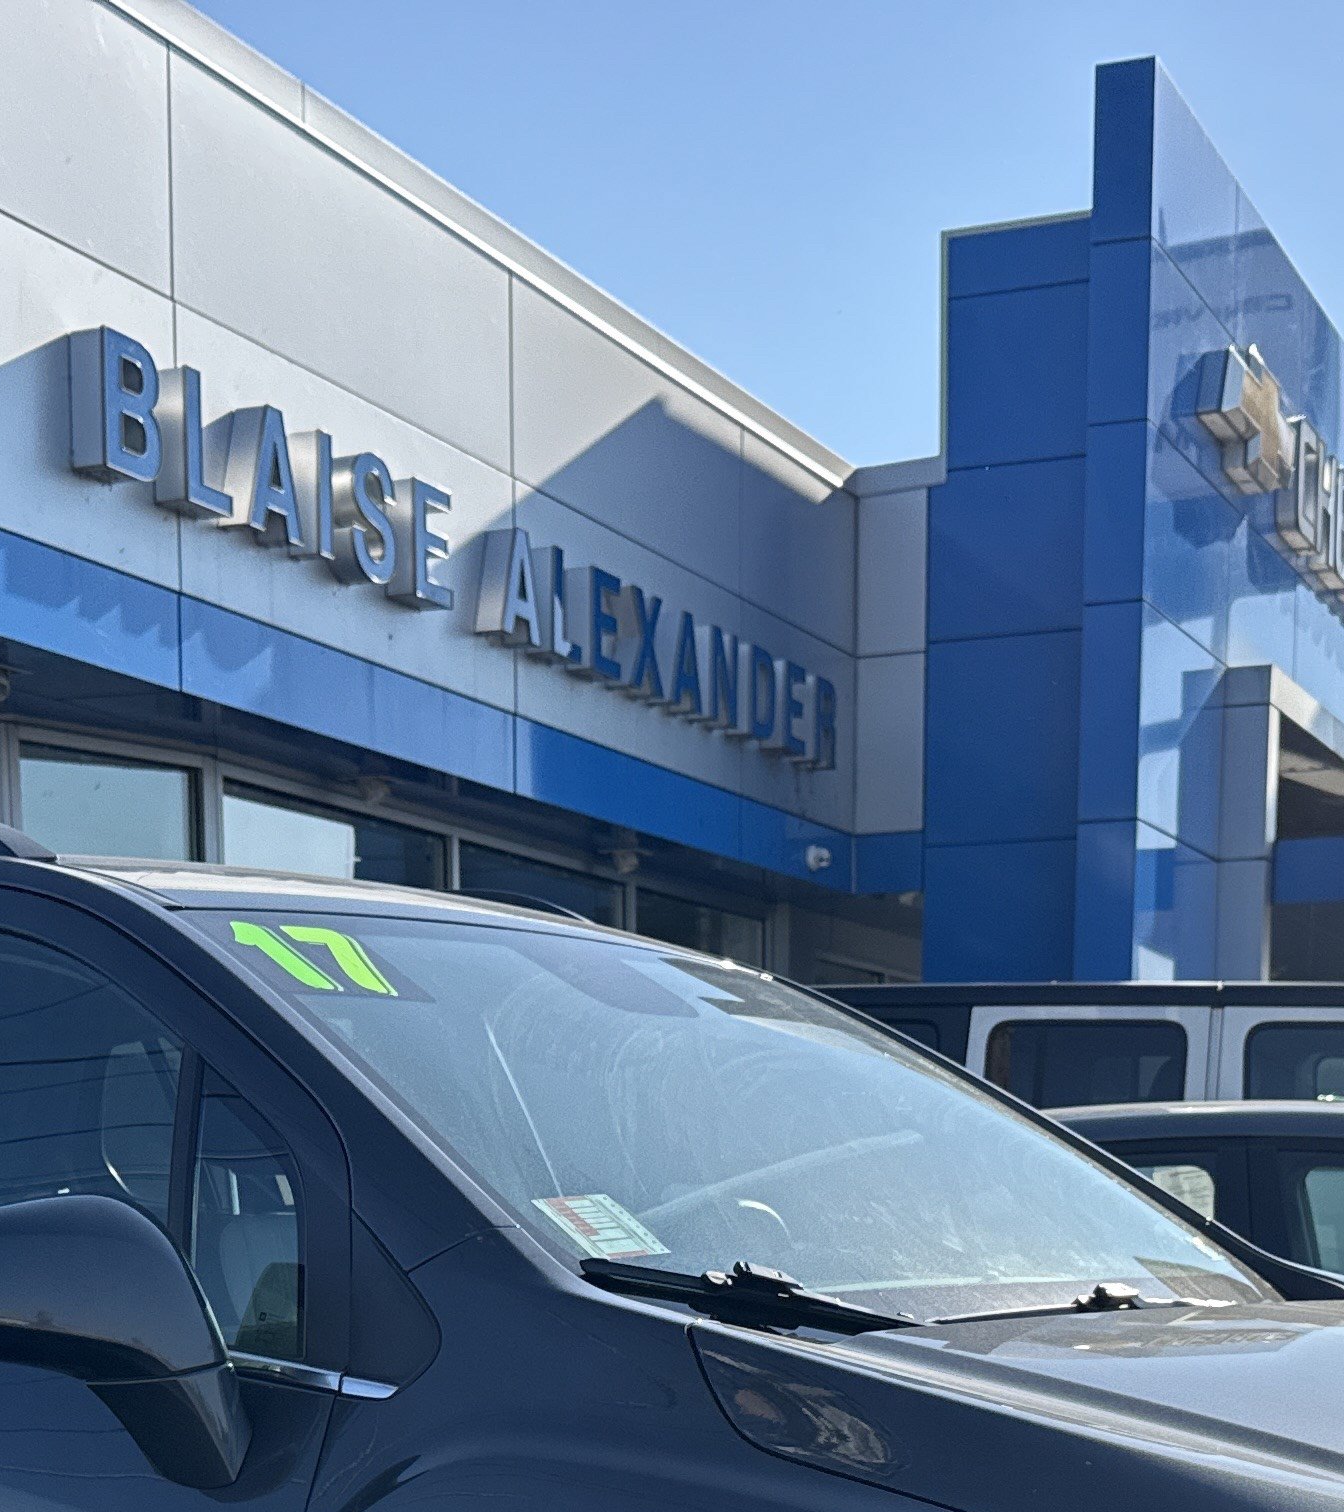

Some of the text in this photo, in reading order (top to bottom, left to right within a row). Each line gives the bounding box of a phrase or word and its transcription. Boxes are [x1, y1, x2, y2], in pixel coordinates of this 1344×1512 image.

[72, 325, 838, 770] BLAISE ALEXANDER
[230, 921, 400, 997] 17
